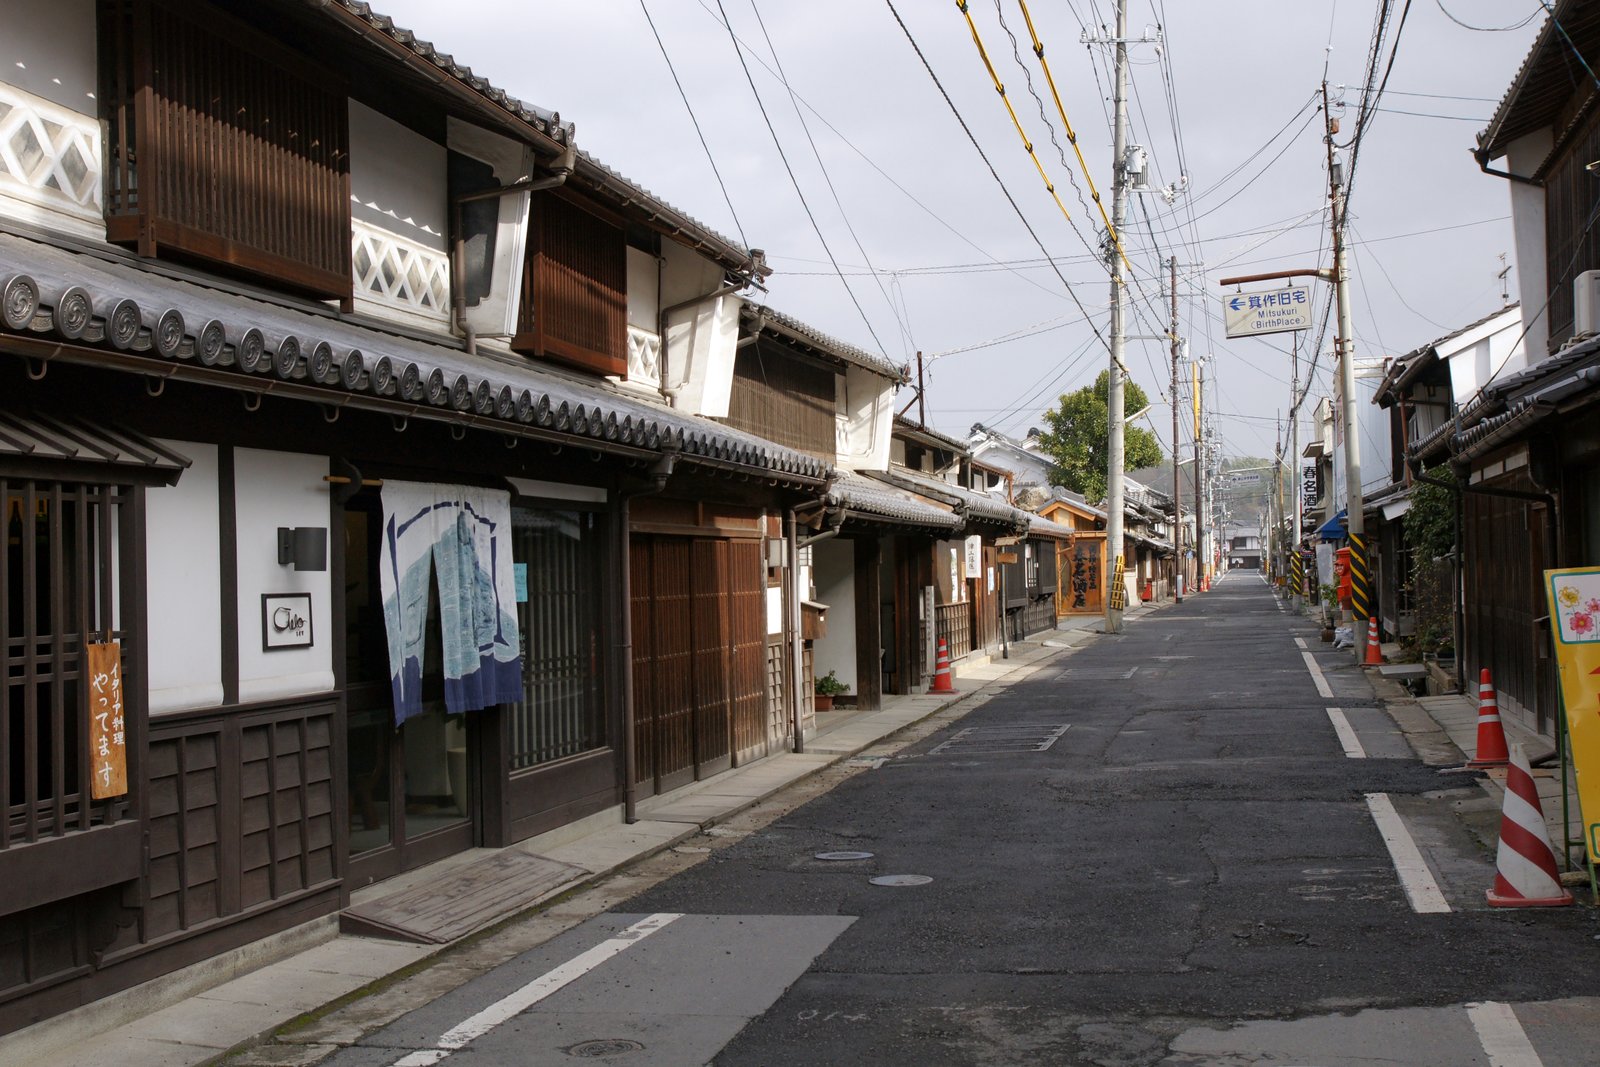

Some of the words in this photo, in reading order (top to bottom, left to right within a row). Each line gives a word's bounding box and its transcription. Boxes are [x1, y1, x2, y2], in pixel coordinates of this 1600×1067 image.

[1249, 291, 1306, 309] 箕作旧宅
[1258, 307, 1298, 319] Mitsukuri
[110, 663, 125, 745] イタリア料理
[92, 672, 113, 787] やってます
